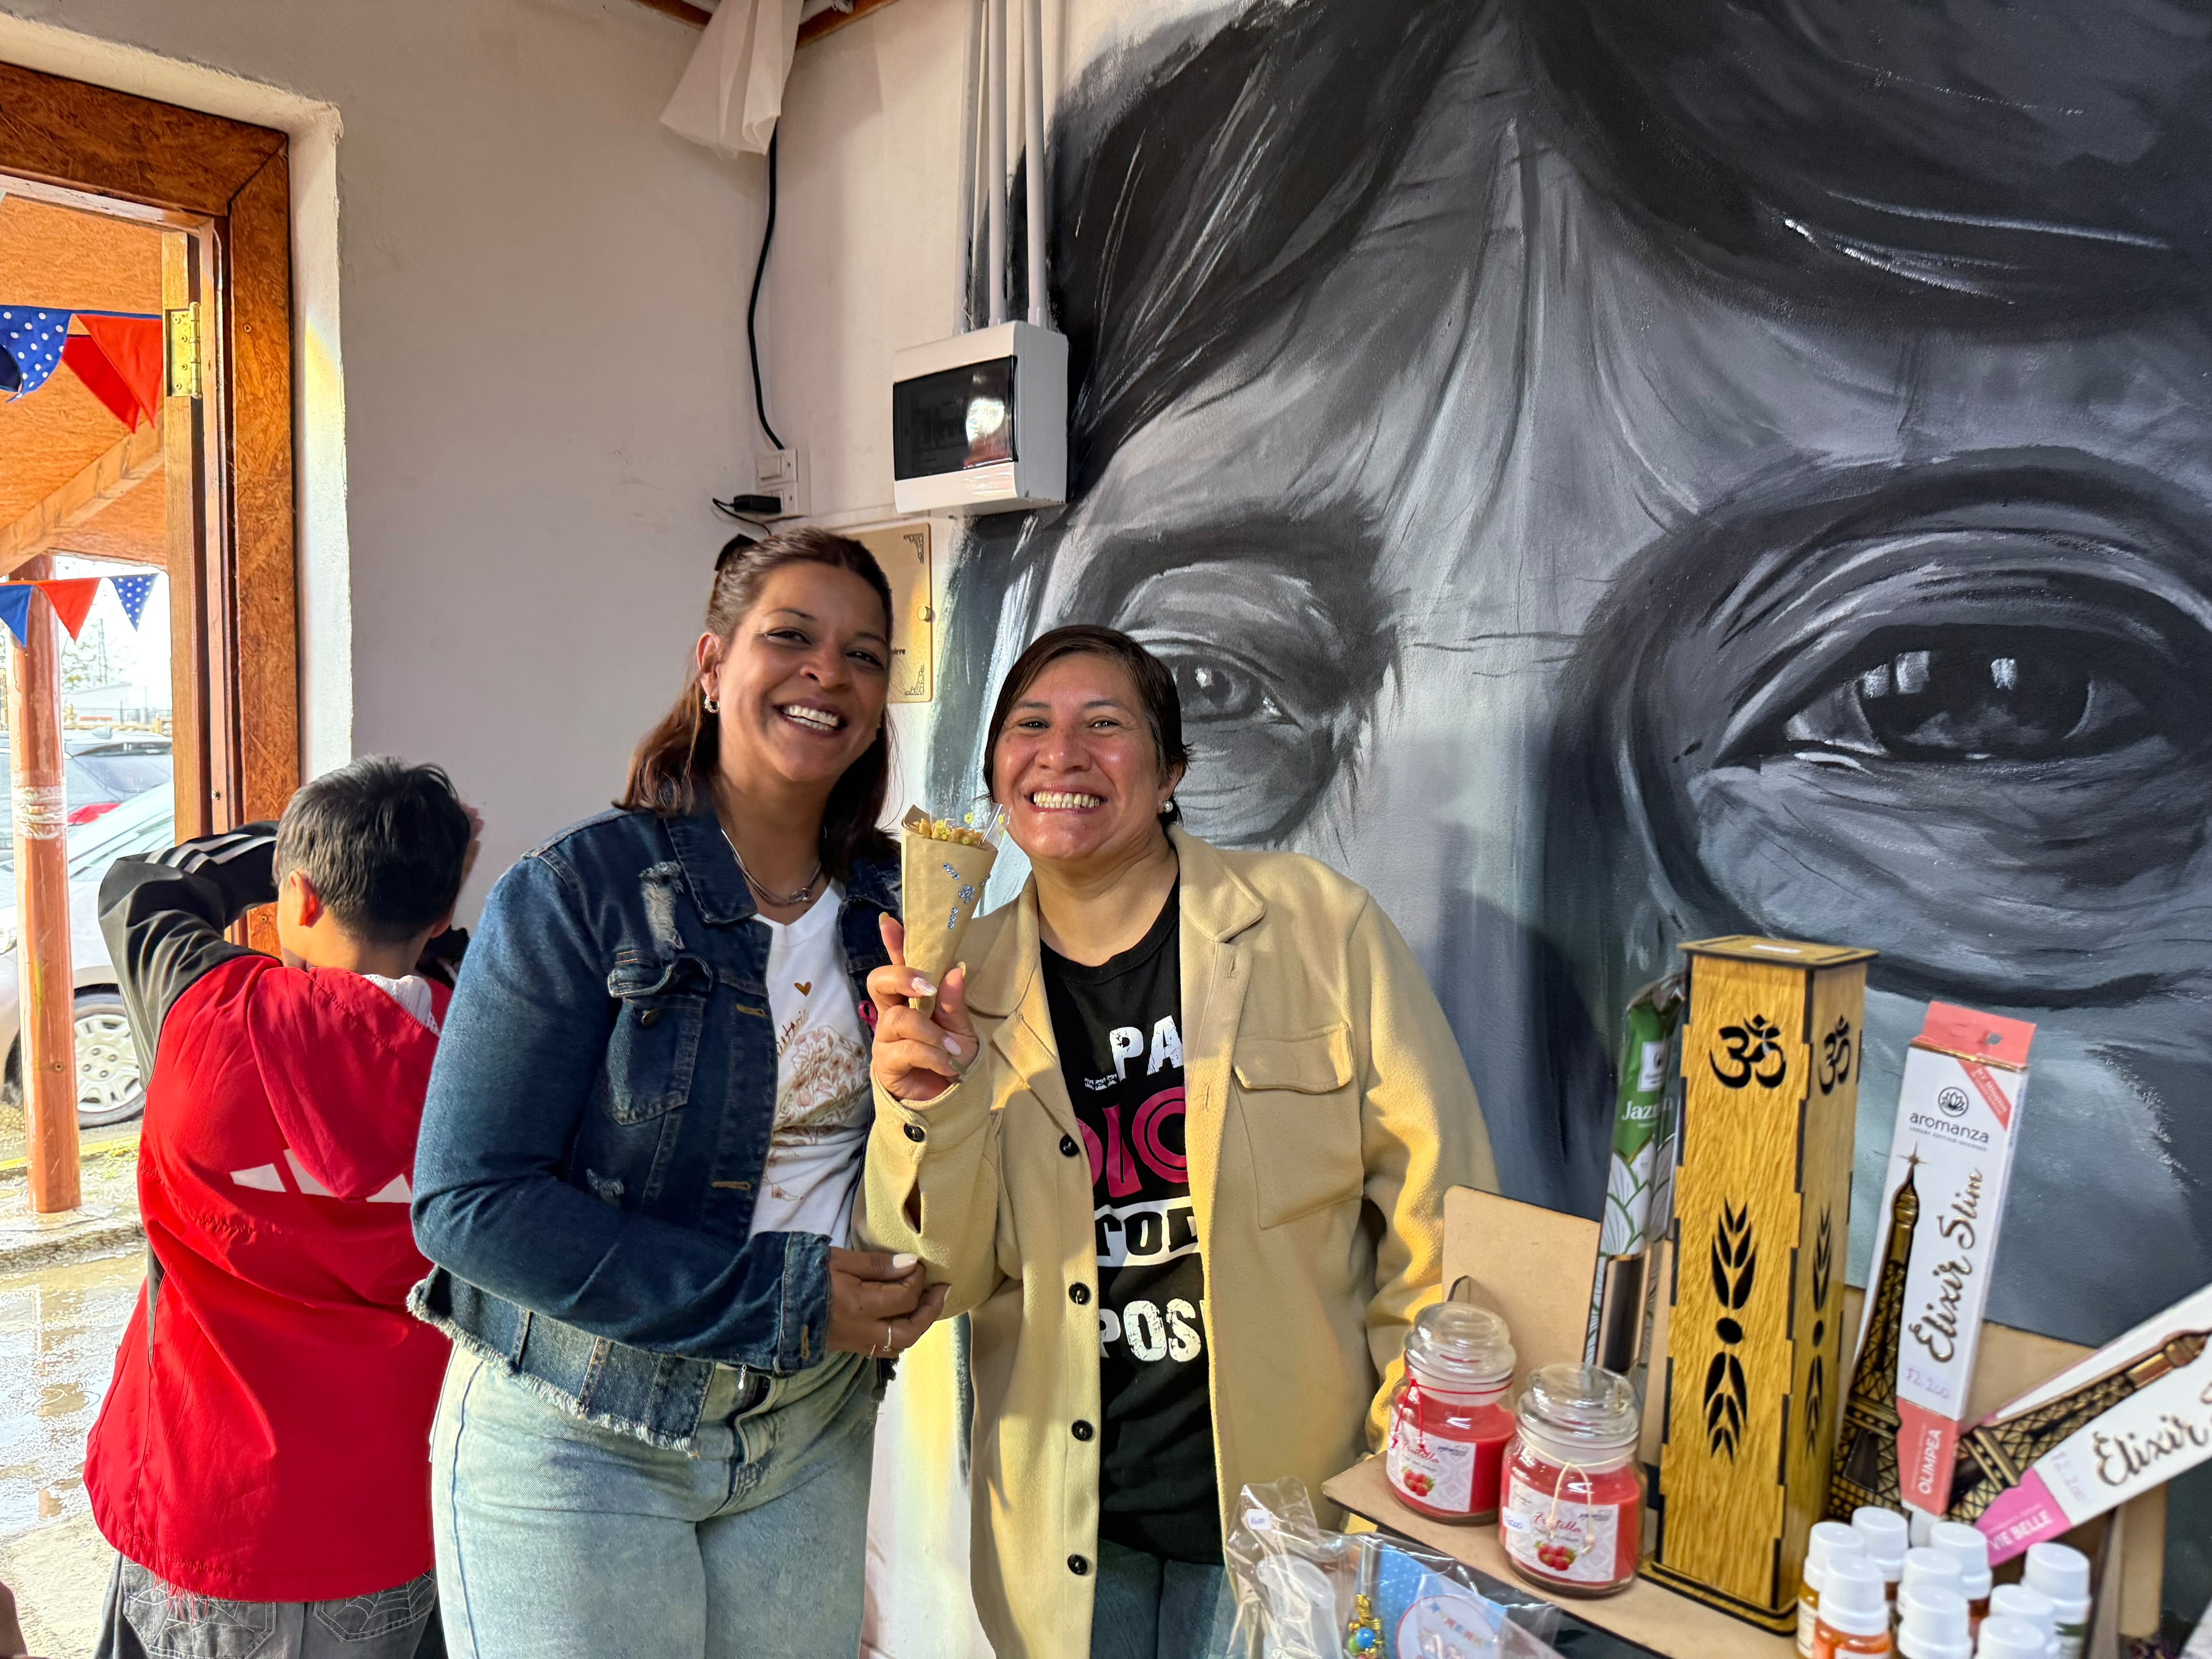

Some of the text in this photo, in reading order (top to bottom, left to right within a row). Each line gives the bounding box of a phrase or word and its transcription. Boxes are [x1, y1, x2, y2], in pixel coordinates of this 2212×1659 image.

[1909, 1112, 1989, 1143] aromanza
[1936, 1167, 1983, 1250] Slim
[1100, 1298, 1205, 1362] POS
[1908, 1255, 1972, 1362] Elixir
[1918, 1429, 1942, 1495] OLIMPEA
[2092, 1415, 2209, 1487] Elixir
[1534, 1511, 1581, 1533] Frtilla
[1987, 1530, 2013, 1551] VIE
[2009, 1509, 2054, 1540] BELLE
